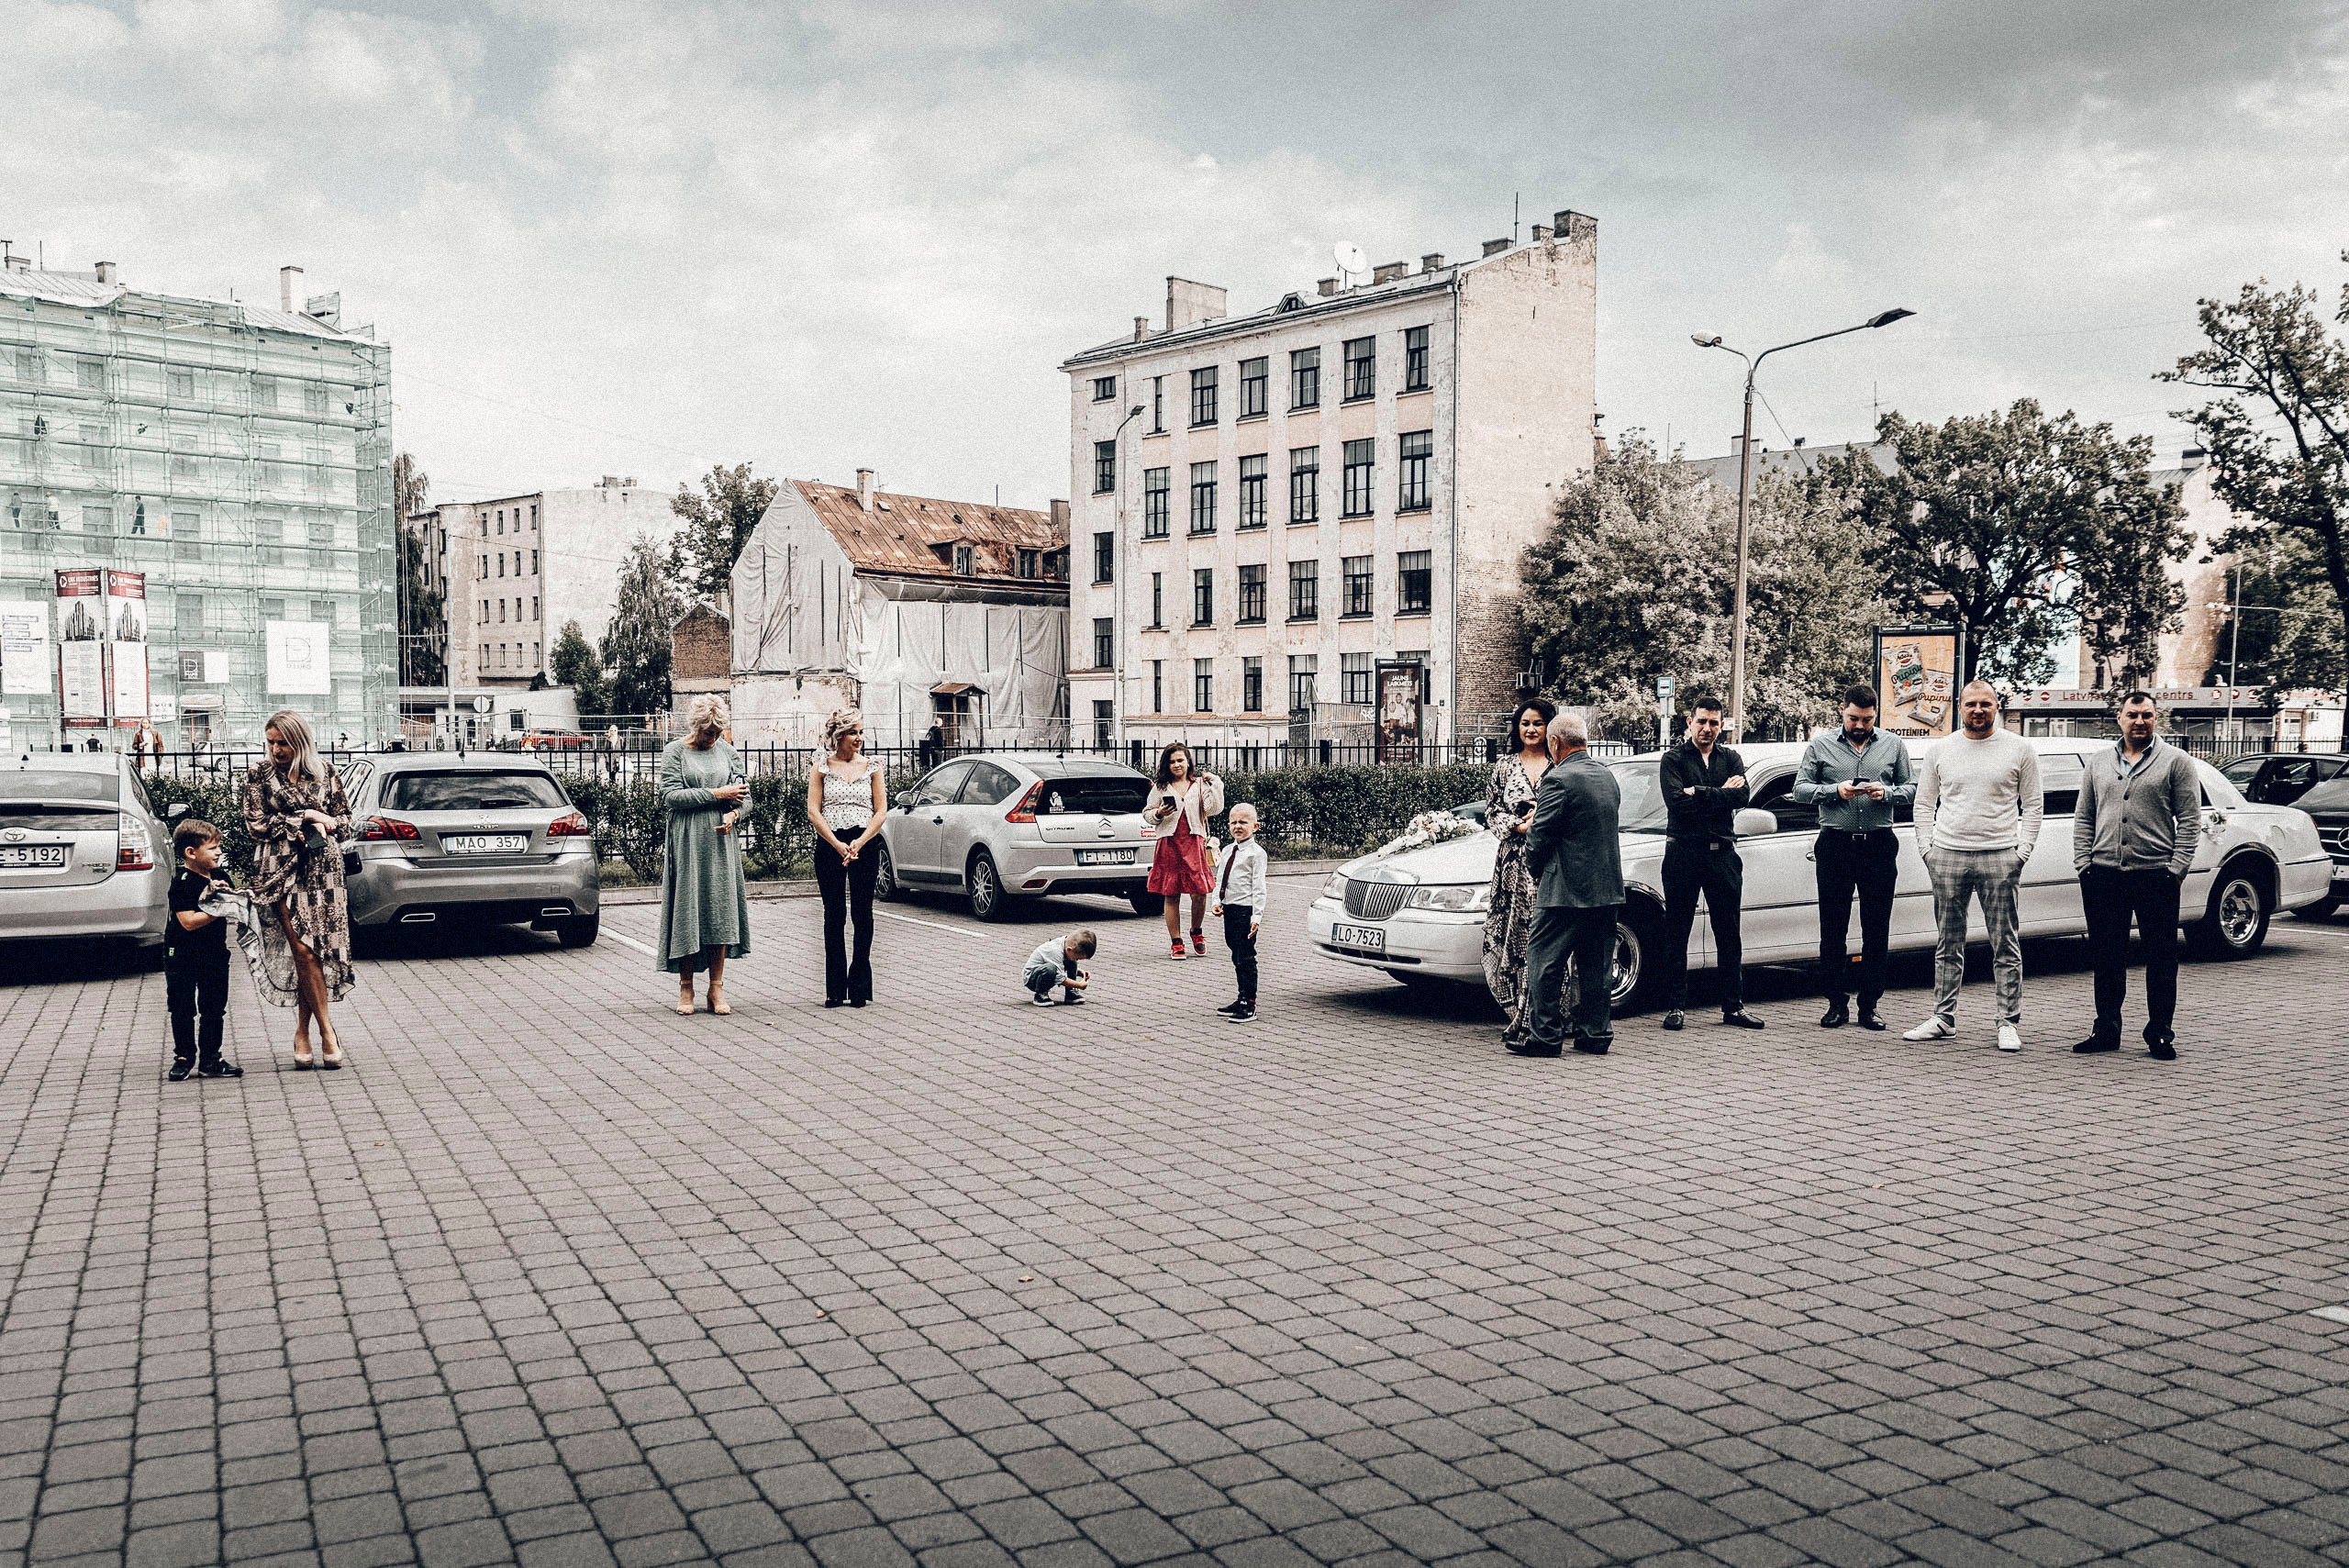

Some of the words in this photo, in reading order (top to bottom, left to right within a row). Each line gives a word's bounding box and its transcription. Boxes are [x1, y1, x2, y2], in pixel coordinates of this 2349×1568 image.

[2155, 691, 2194, 700] centrs
[455, 837, 486, 850] MAO
[496, 836, 520, 848] 357
[1085, 850, 1132, 862] FT-1180
[1338, 926, 1382, 947] LO-7523
